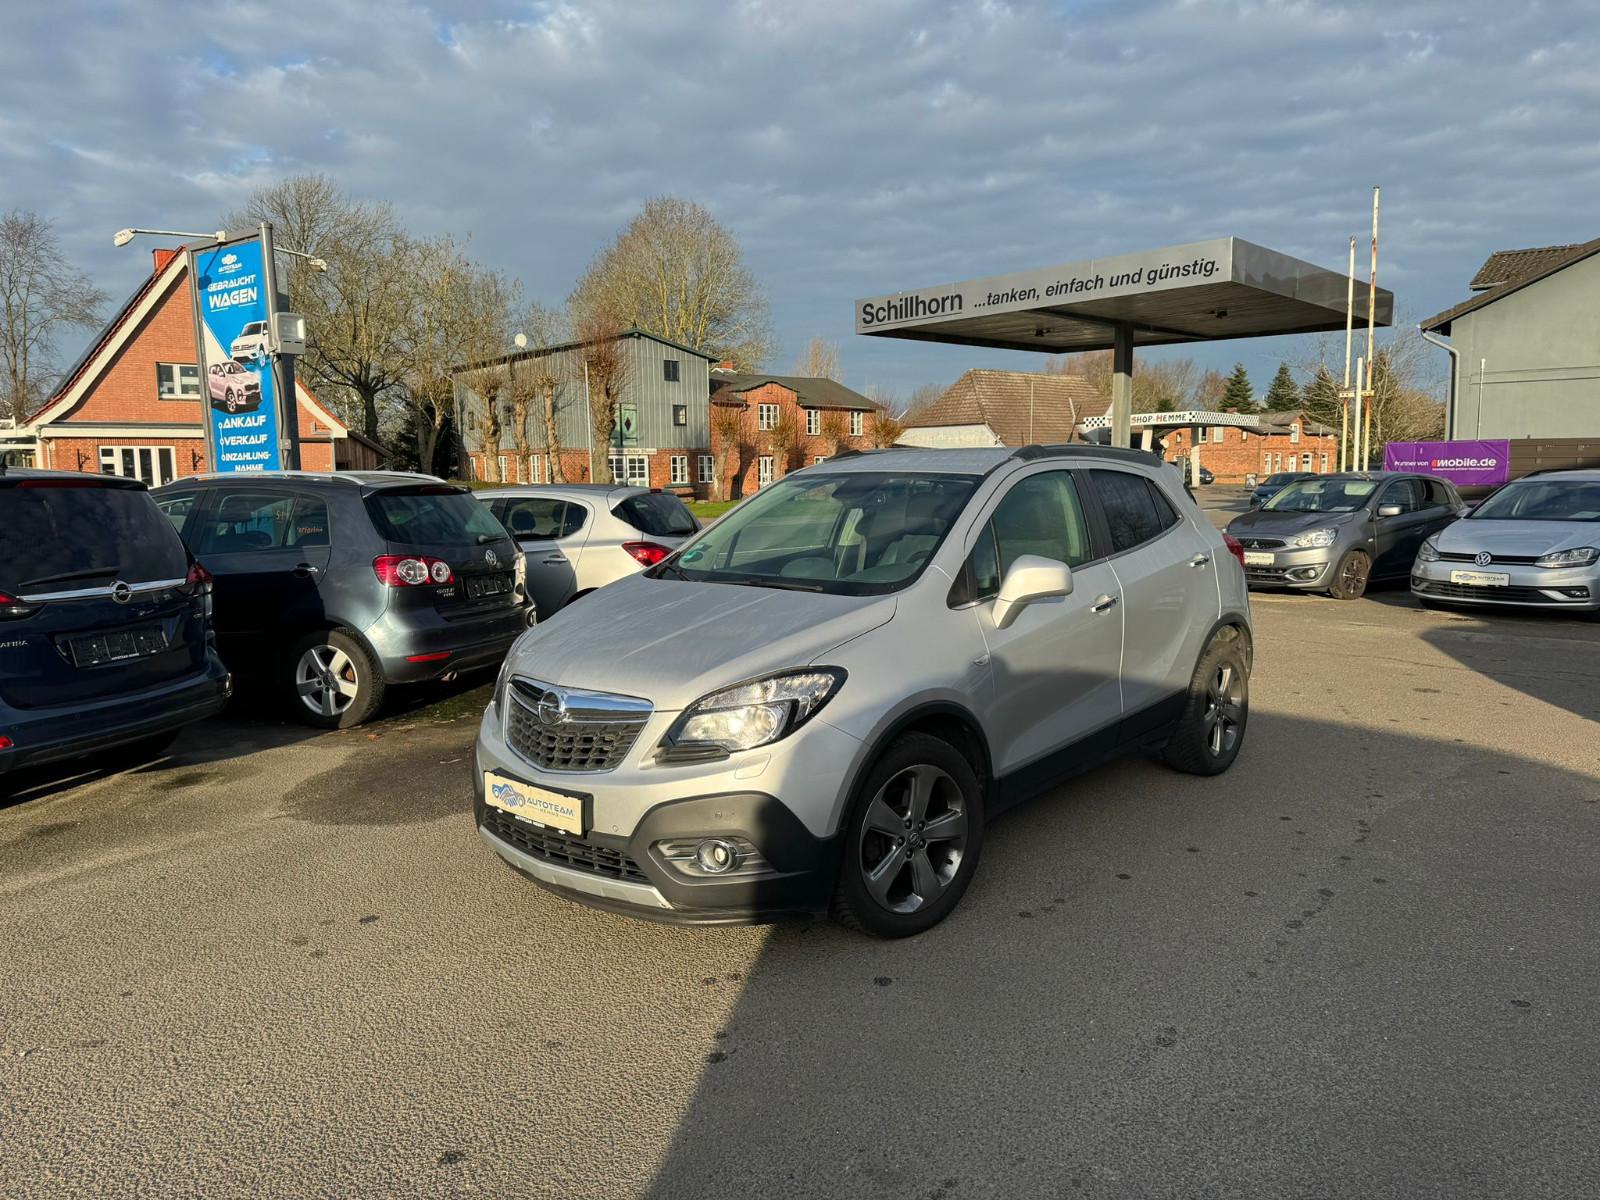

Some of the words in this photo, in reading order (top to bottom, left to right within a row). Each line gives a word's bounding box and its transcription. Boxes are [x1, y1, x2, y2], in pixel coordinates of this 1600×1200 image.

[208, 274, 256, 292] GEBRAUCHT
[209, 286, 257, 309] WAGEN
[862, 293, 963, 325] Schillhorn
[1045, 274, 1104, 297] einfach
[1109, 267, 1143, 288] und
[1146, 258, 1220, 285] günstig.
[223, 415, 266, 428] ANKAUF
[1156, 413, 1187, 423] HEMME
[224, 434, 268, 446] VERKAUF
[235, 463, 264, 472] NAHME
[1434, 458, 1497, 467] mobile.de
[526, 797, 574, 816] AUTOTEAM
